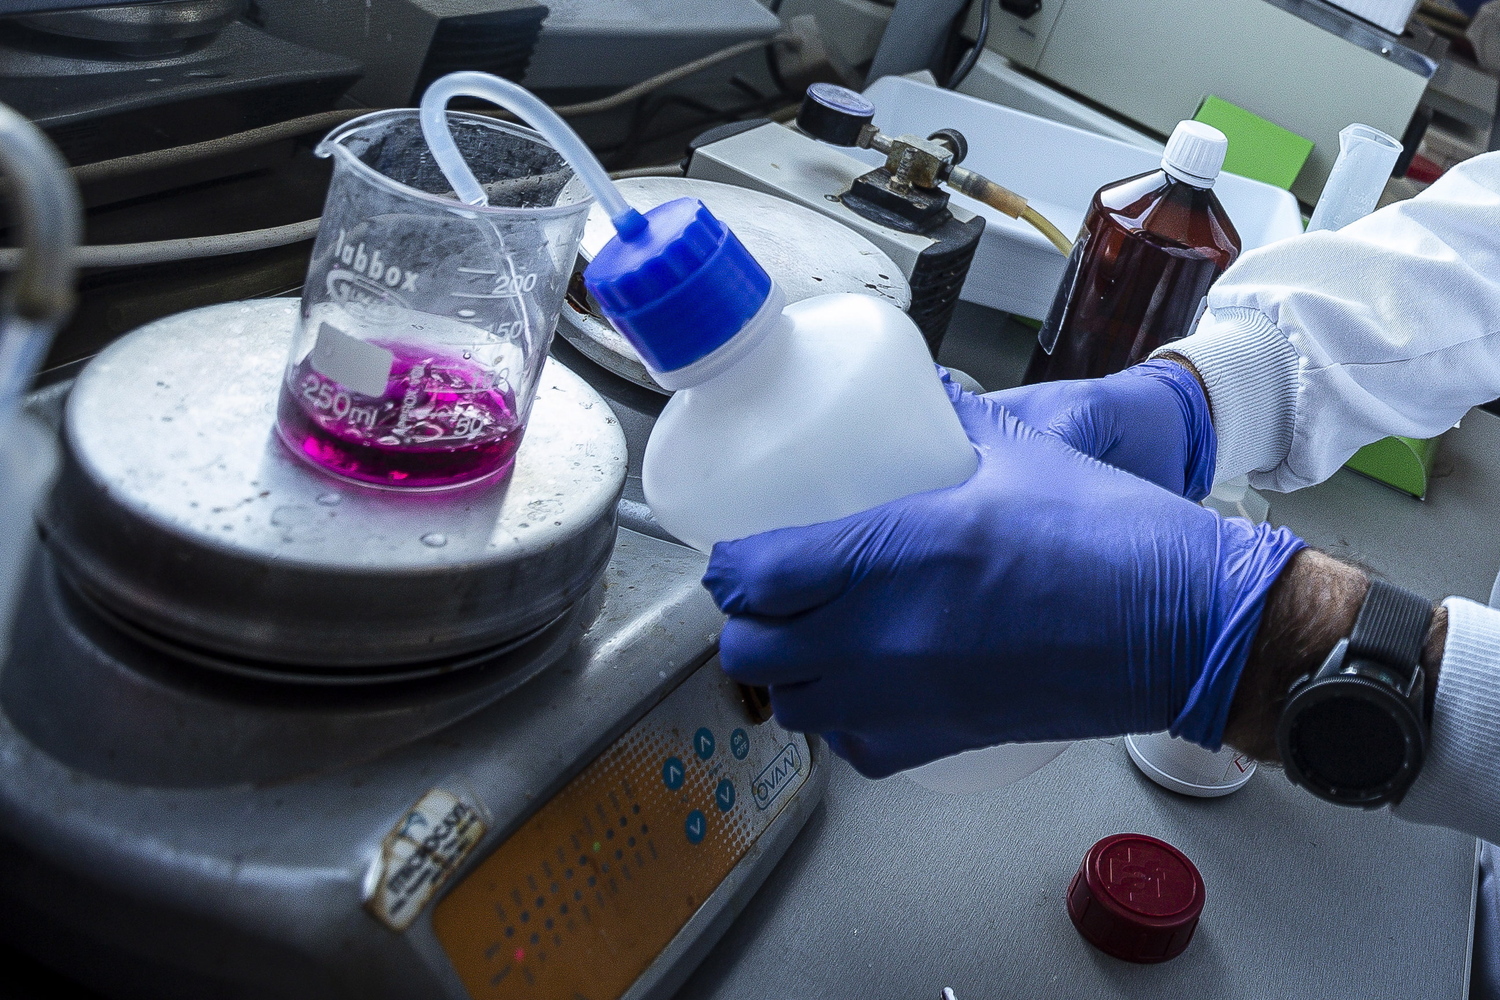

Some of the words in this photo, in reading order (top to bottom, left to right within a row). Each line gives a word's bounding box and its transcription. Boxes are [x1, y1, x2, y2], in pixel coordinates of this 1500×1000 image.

[334, 228, 420, 293] labbox
[491, 273, 537, 295] 200
[454, 418, 485, 437] 50
[756, 749, 797, 802] OVAN
